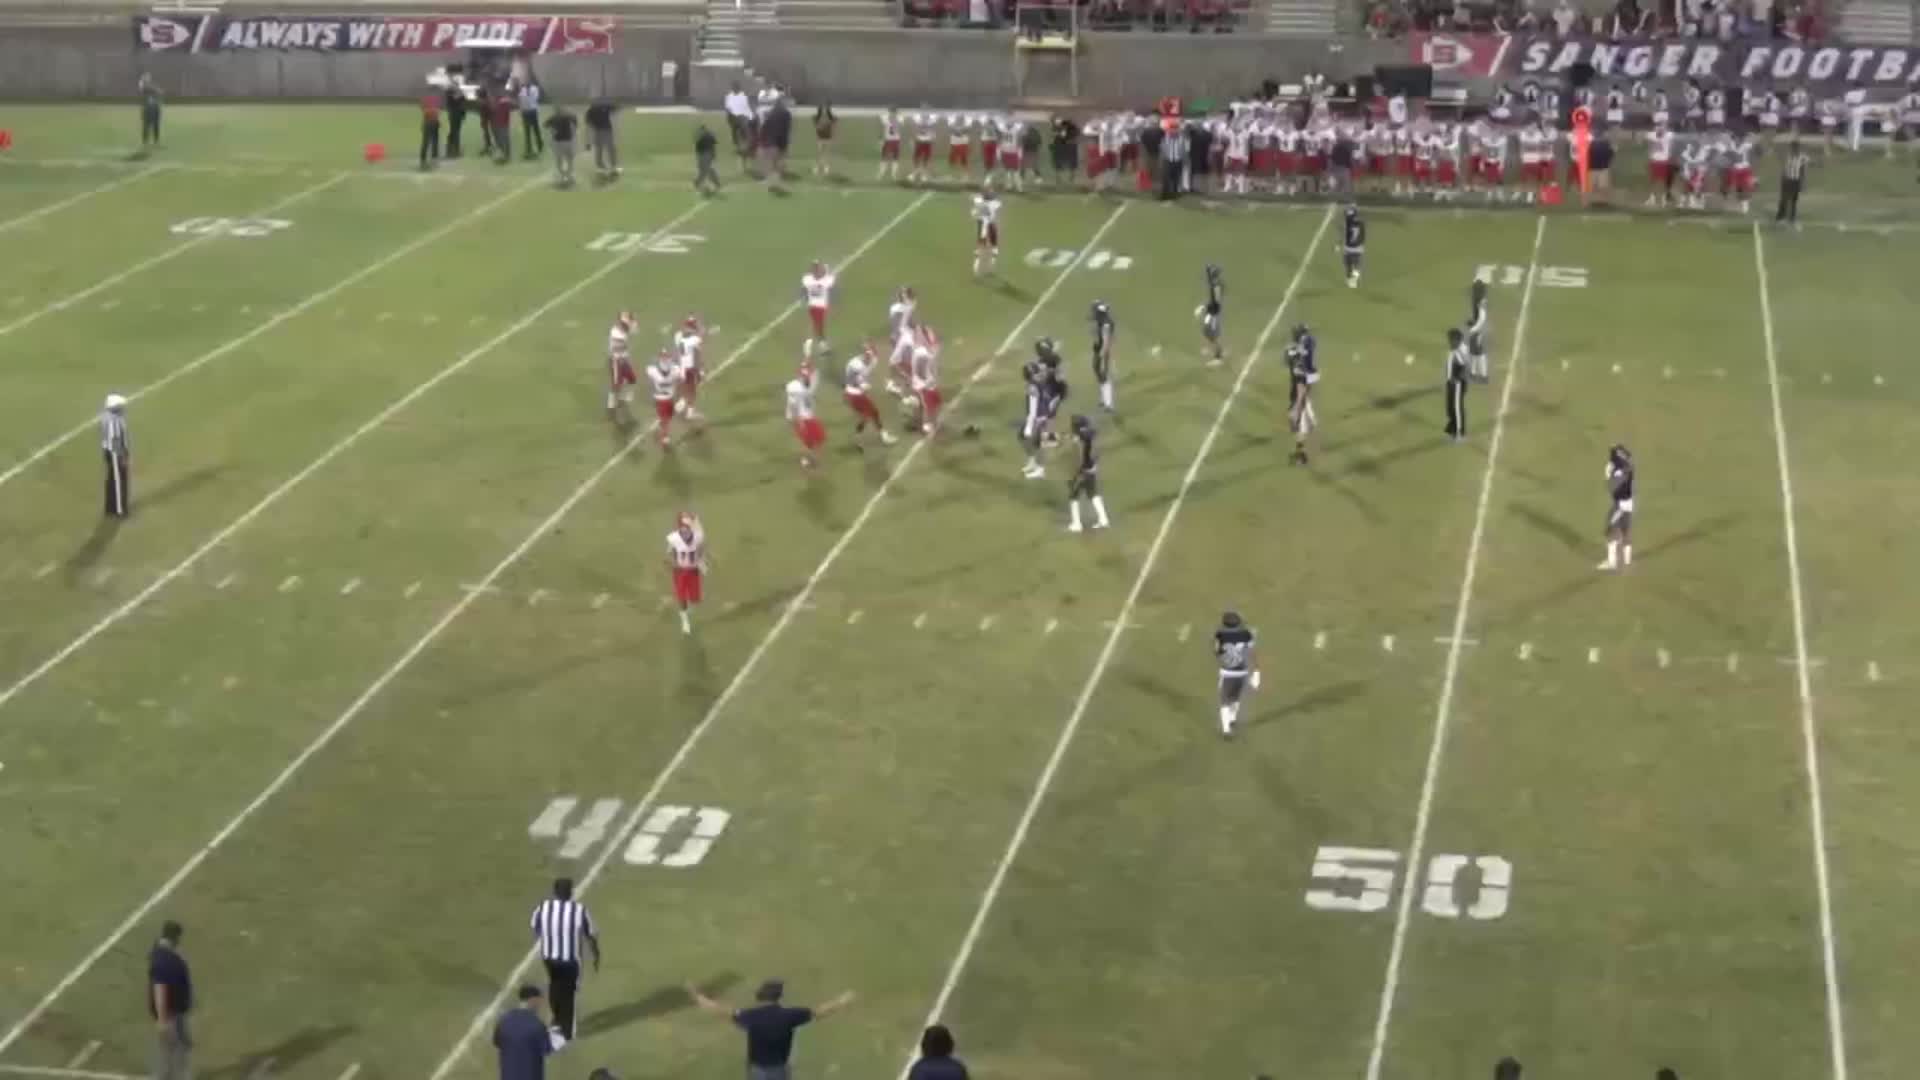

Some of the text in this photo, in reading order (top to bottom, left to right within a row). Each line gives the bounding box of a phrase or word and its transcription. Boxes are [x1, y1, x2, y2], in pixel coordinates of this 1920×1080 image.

[221, 21, 341, 48] ALWAYS
[349, 23, 425, 48] WITH
[1522, 40, 1720, 77] SANGER
[528, 797, 732, 866] 40
[1304, 846, 1512, 919] 50
